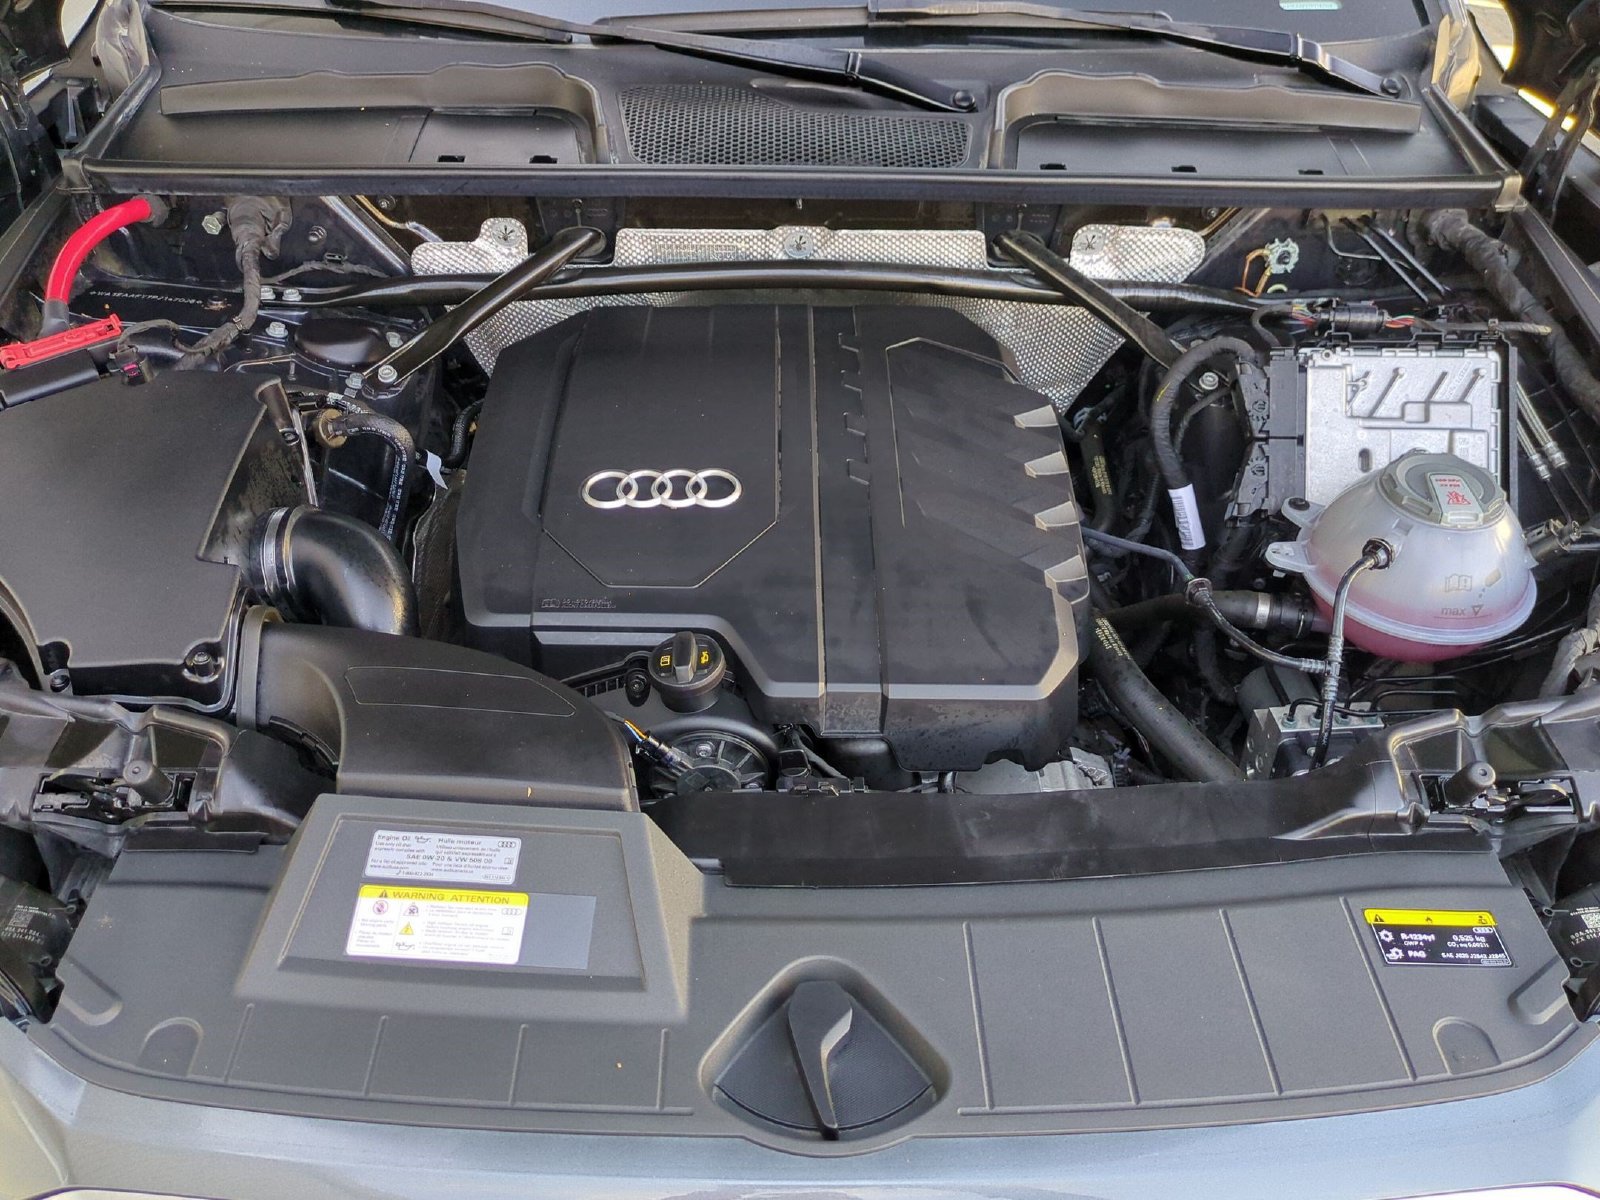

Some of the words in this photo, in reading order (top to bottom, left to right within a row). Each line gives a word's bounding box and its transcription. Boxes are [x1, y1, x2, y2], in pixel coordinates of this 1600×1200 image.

[1441, 607, 1466, 616] max
[392, 890, 445, 901] WARNING
[450, 893, 510, 905] ATTENTION
[1475, 934, 1486, 943] kg
[1407, 950, 1427, 958] PAG
